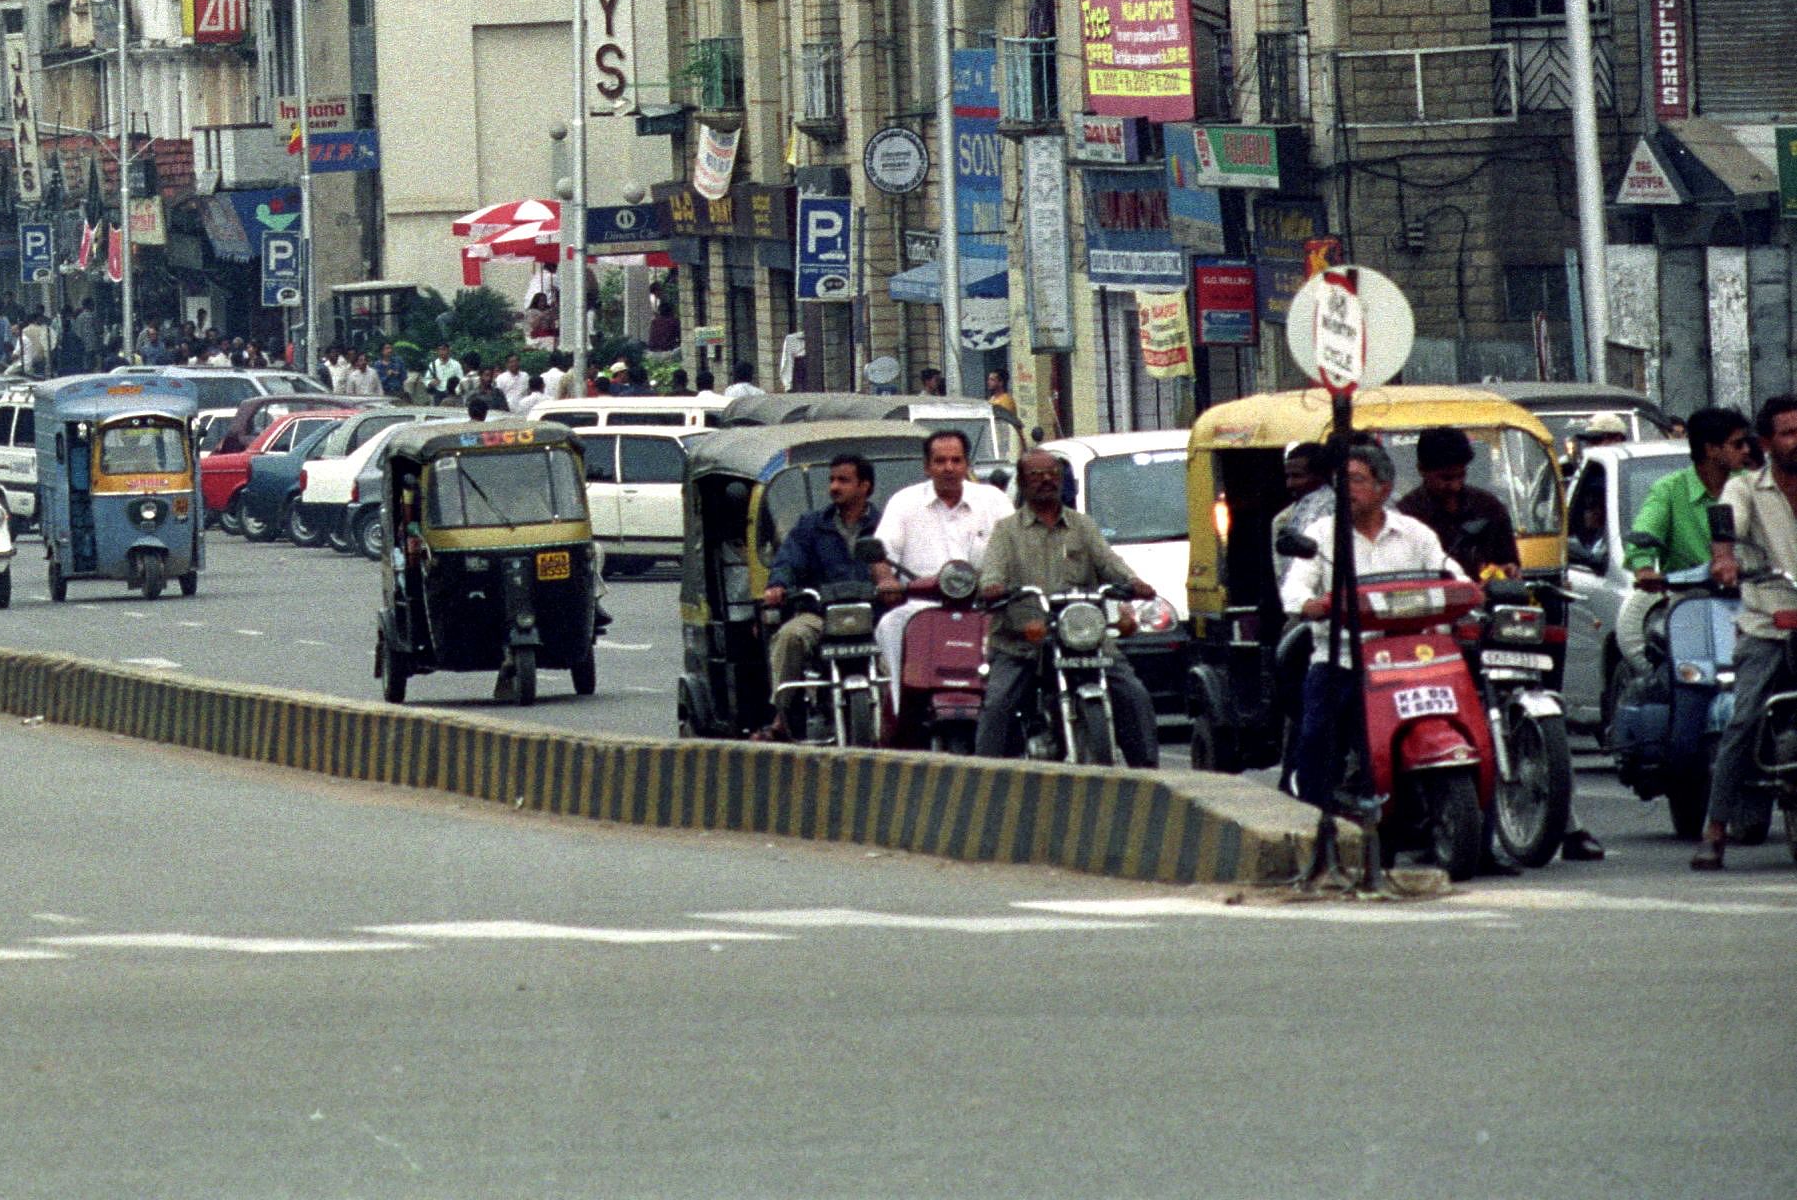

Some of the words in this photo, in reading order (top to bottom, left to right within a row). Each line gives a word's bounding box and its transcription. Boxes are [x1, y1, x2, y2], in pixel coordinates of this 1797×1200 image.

[1081, 0, 1112, 40] Free
[10, 51, 35, 192] JAMALS
[280, 101, 346, 119] Iniana
[959, 132, 1002, 177] SON
[25, 231, 46, 256] P
[807, 210, 842, 253] P
[268, 240, 294, 271] P
